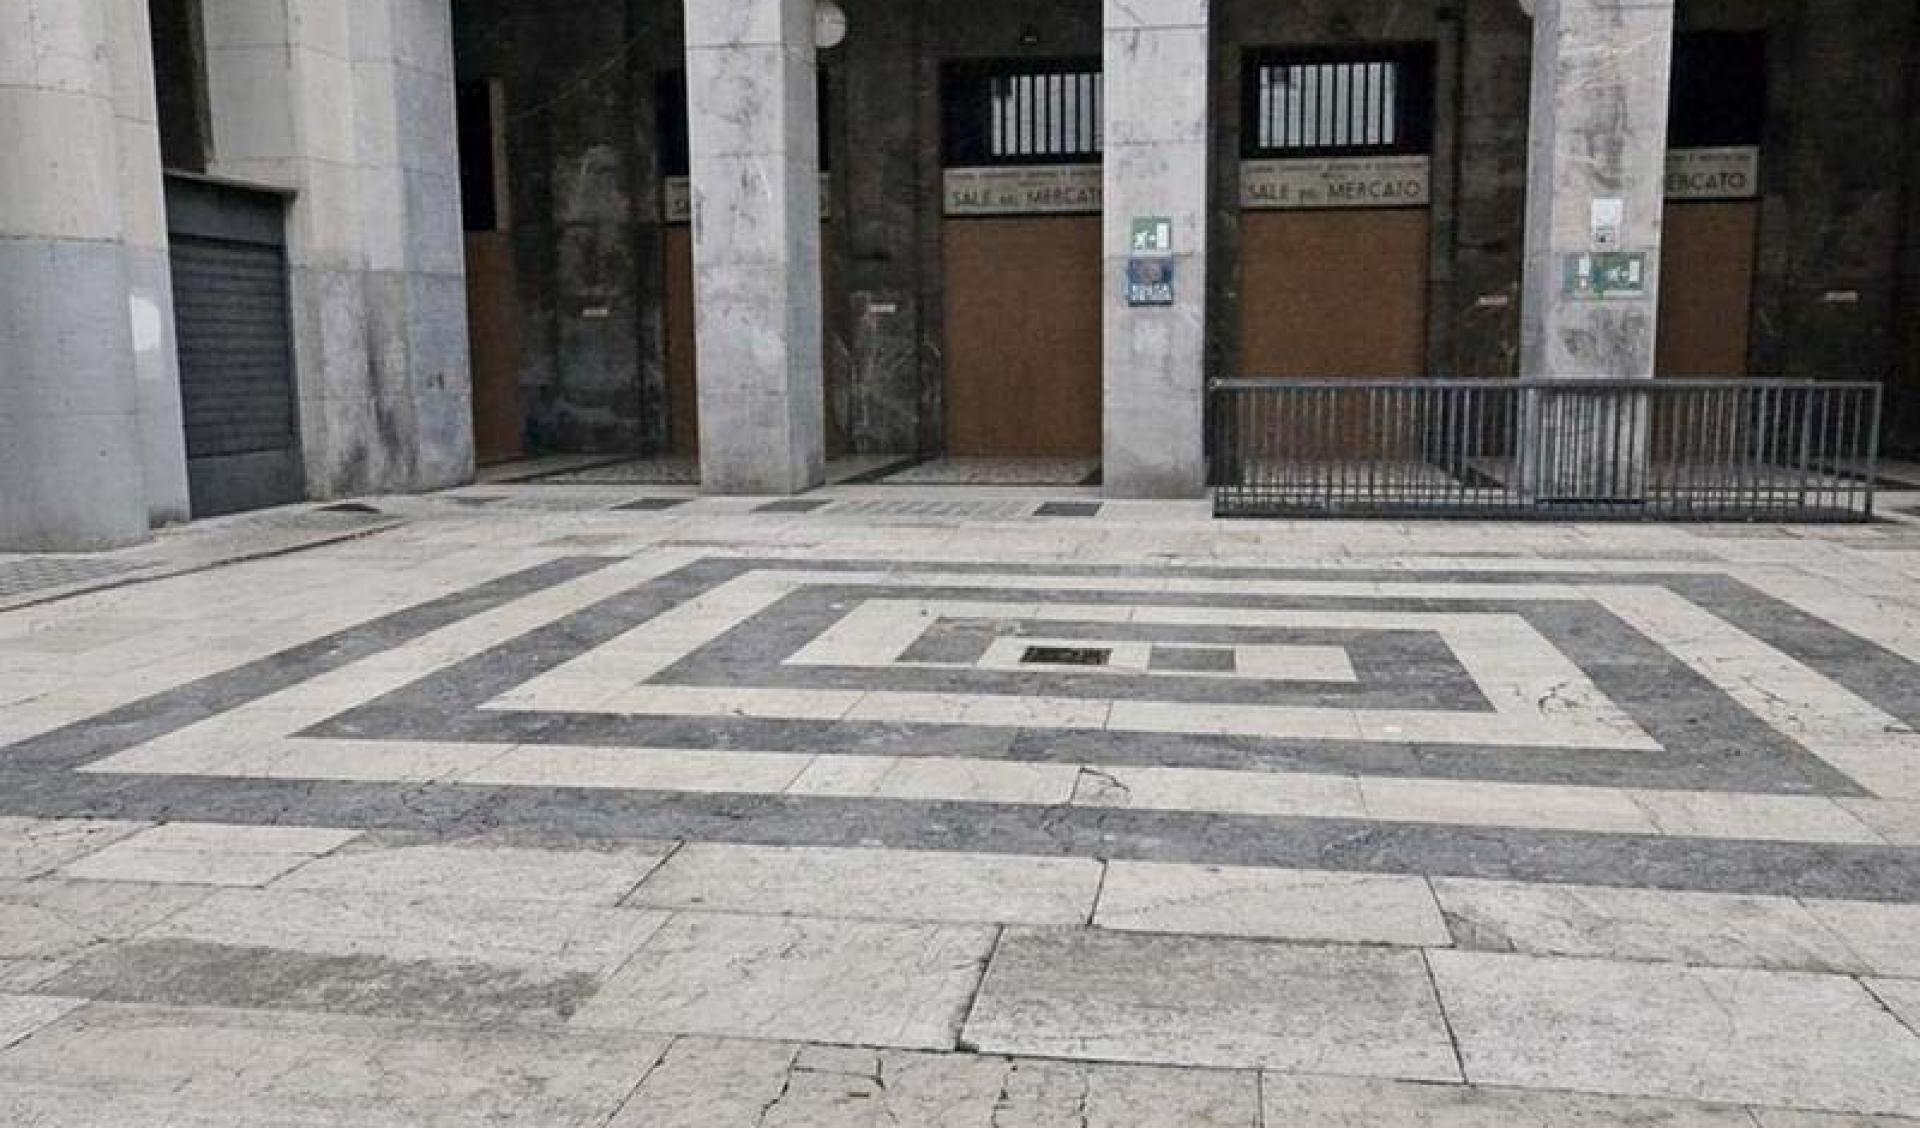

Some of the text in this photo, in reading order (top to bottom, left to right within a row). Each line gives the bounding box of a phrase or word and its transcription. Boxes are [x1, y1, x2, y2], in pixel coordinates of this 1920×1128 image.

[1248, 183, 1289, 200] SALE
[1328, 179, 1421, 198] MERCATO
[1666, 172, 1747, 191] ERCATO
[1026, 184, 1103, 205] MERCAT
